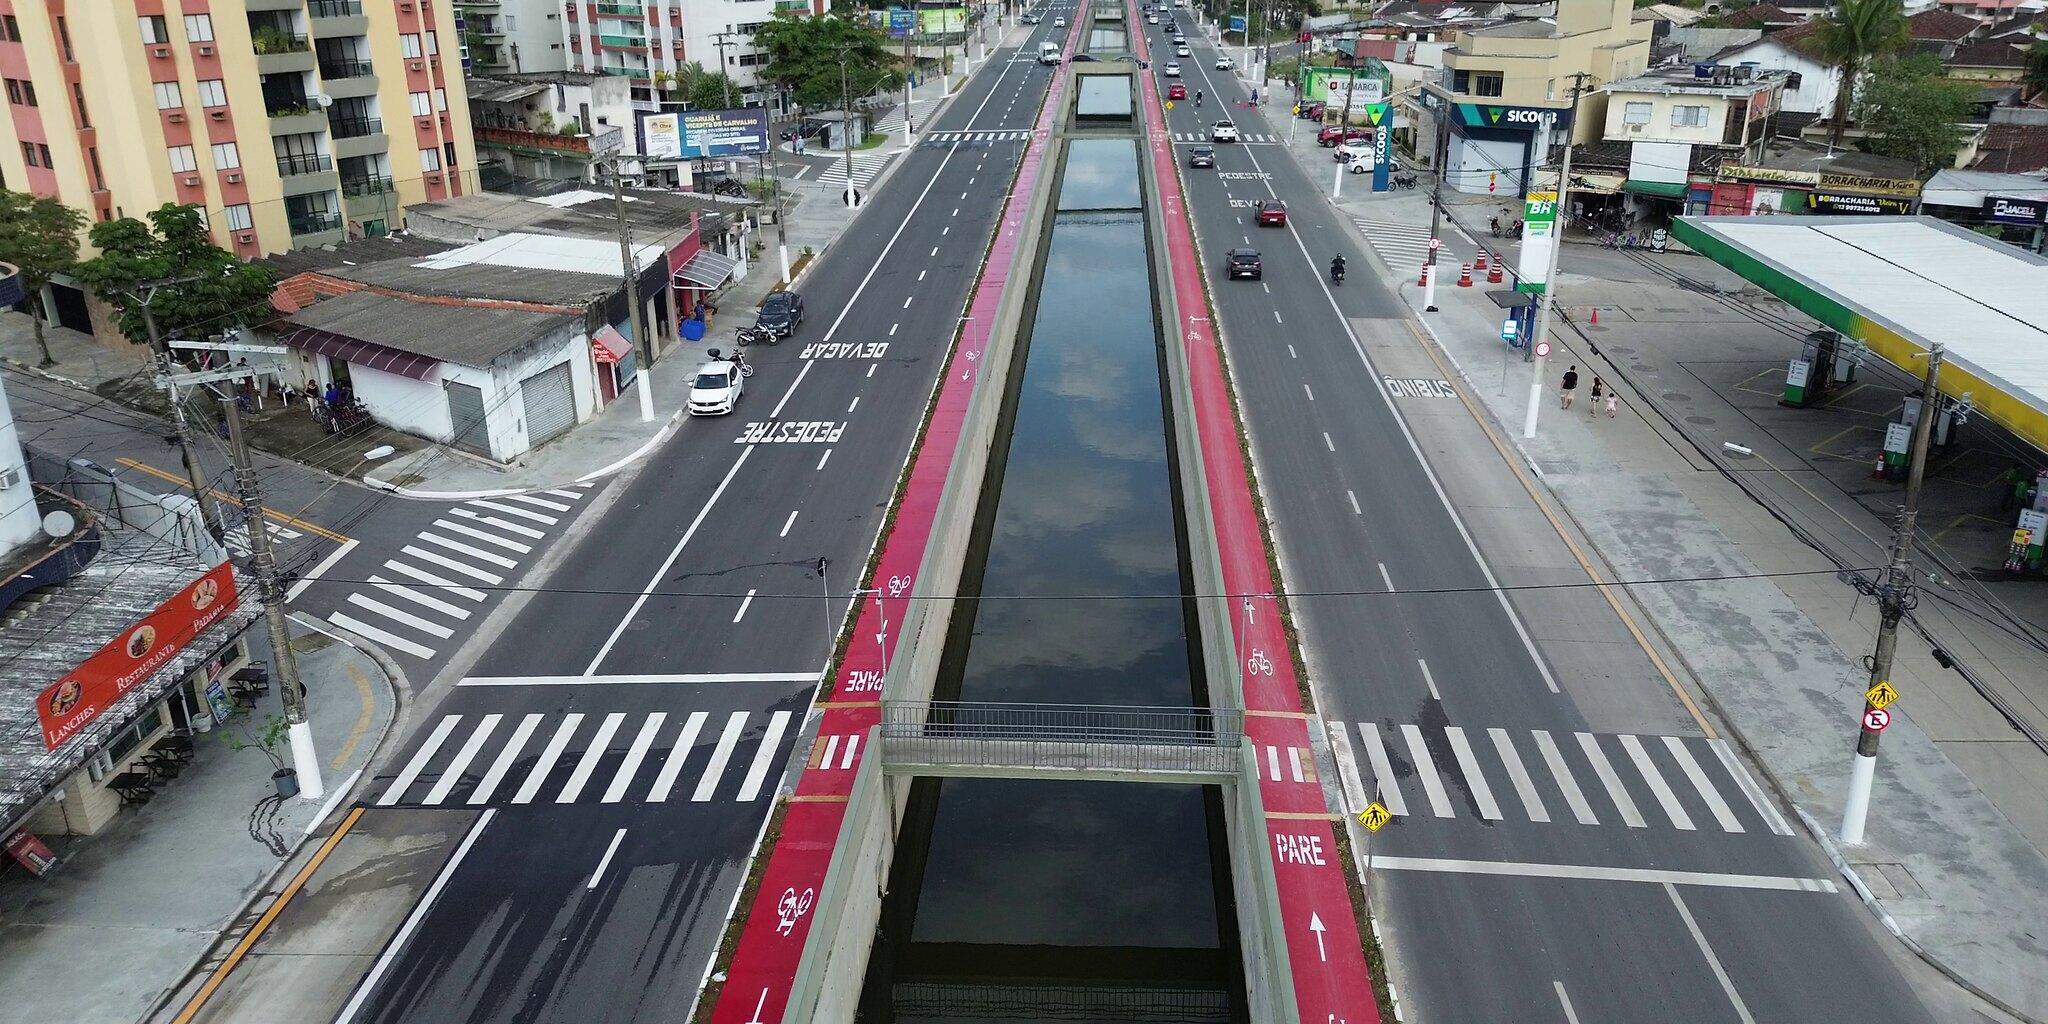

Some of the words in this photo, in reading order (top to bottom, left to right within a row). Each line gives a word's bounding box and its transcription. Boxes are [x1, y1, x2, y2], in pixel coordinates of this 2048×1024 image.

[723, 118, 758, 126] CARVALHO
[1376, 125, 1387, 165] SICOOB
[1218, 172, 1273, 180] PEDESTRE
[1821, 175, 1891, 189] BORRACHARIA
[1529, 202, 1551, 215] BR
[1818, 195, 1876, 205] BORRACHARIA
[799, 342, 890, 359] DEVAGAR
[1383, 375, 1458, 397] ÔNIBUS
[733, 421, 848, 443] PEDESTRE
[192, 604, 225, 633] PADARIA
[115, 643, 176, 693] RESTAURANTE
[845, 670, 884, 692] PARE
[49, 704, 96, 745] LANCHES
[1275, 833, 1327, 866] PARE
